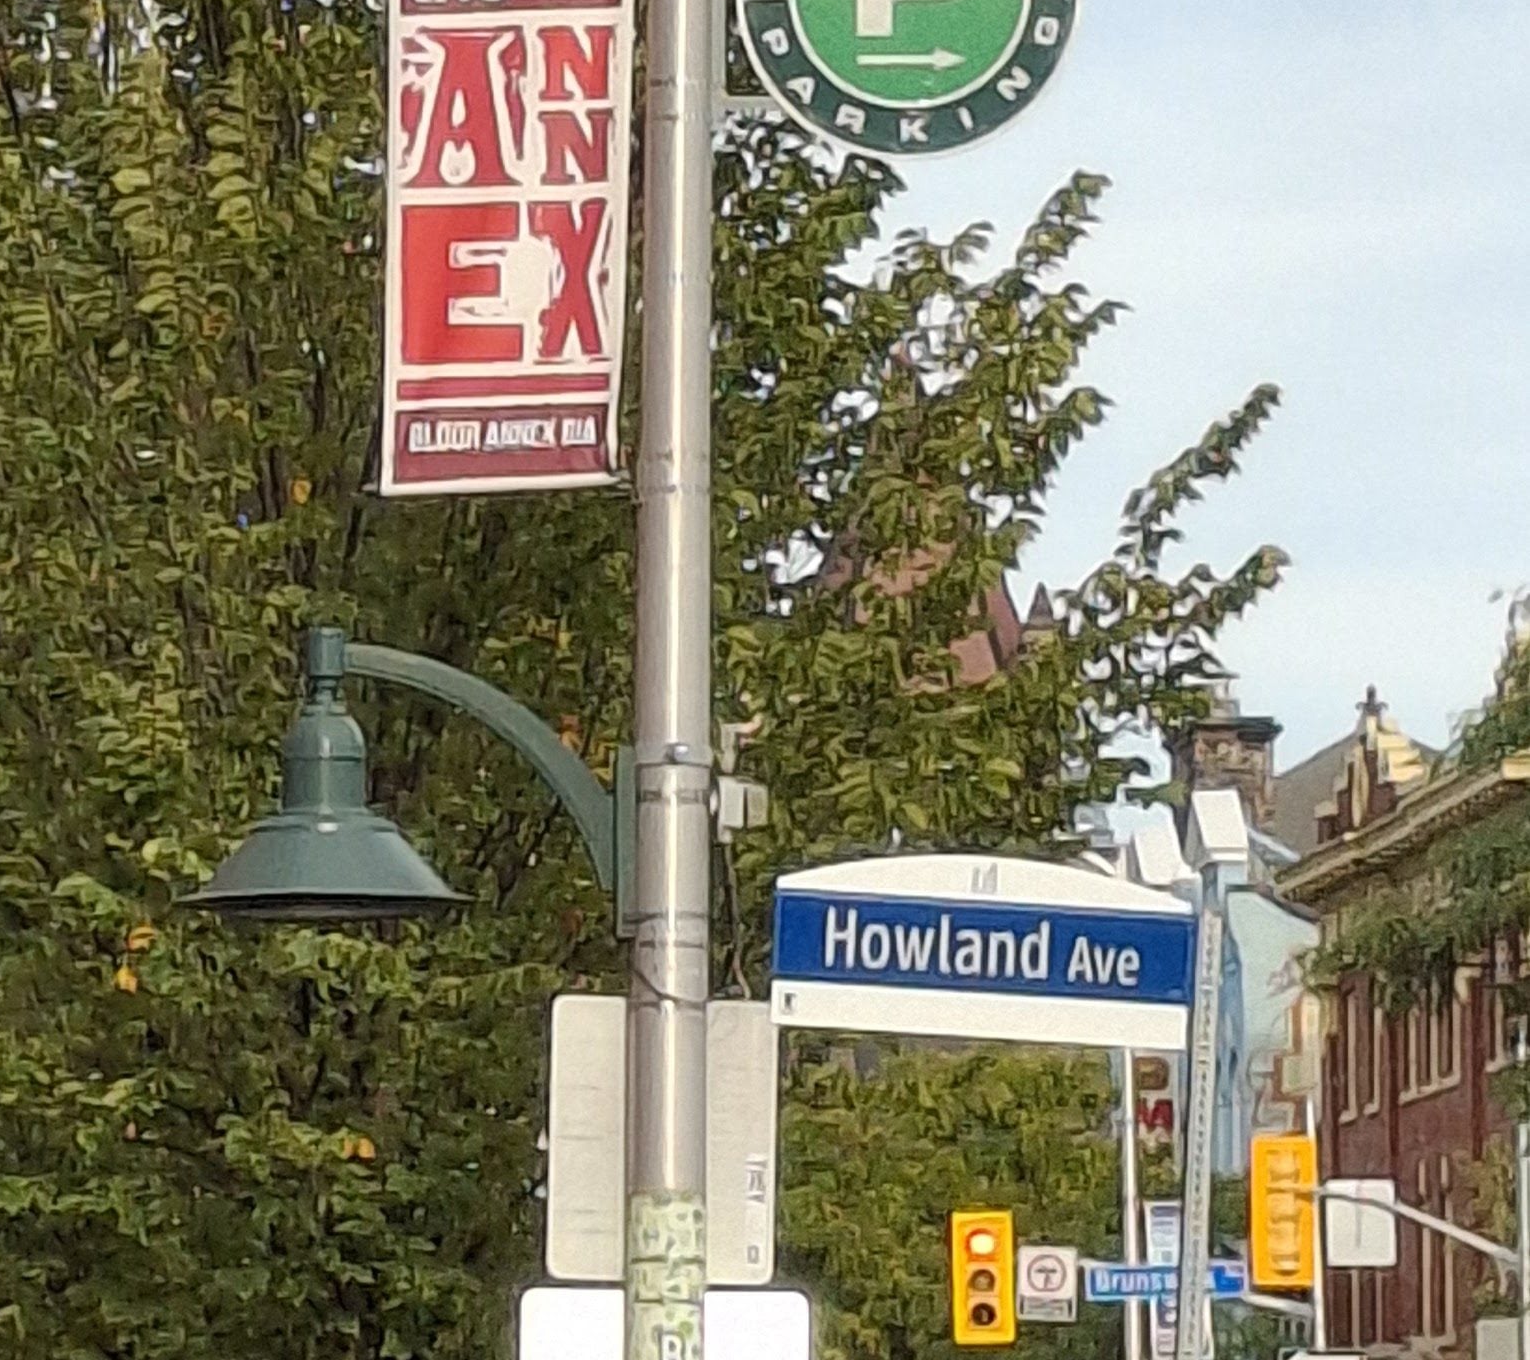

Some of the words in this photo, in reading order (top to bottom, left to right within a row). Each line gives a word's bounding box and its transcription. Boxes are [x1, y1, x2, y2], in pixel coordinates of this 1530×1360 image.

[760, 15, 1061, 144] PARKING
[824, 906, 1051, 981] Howland
[1066, 935, 1141, 986] Ave
